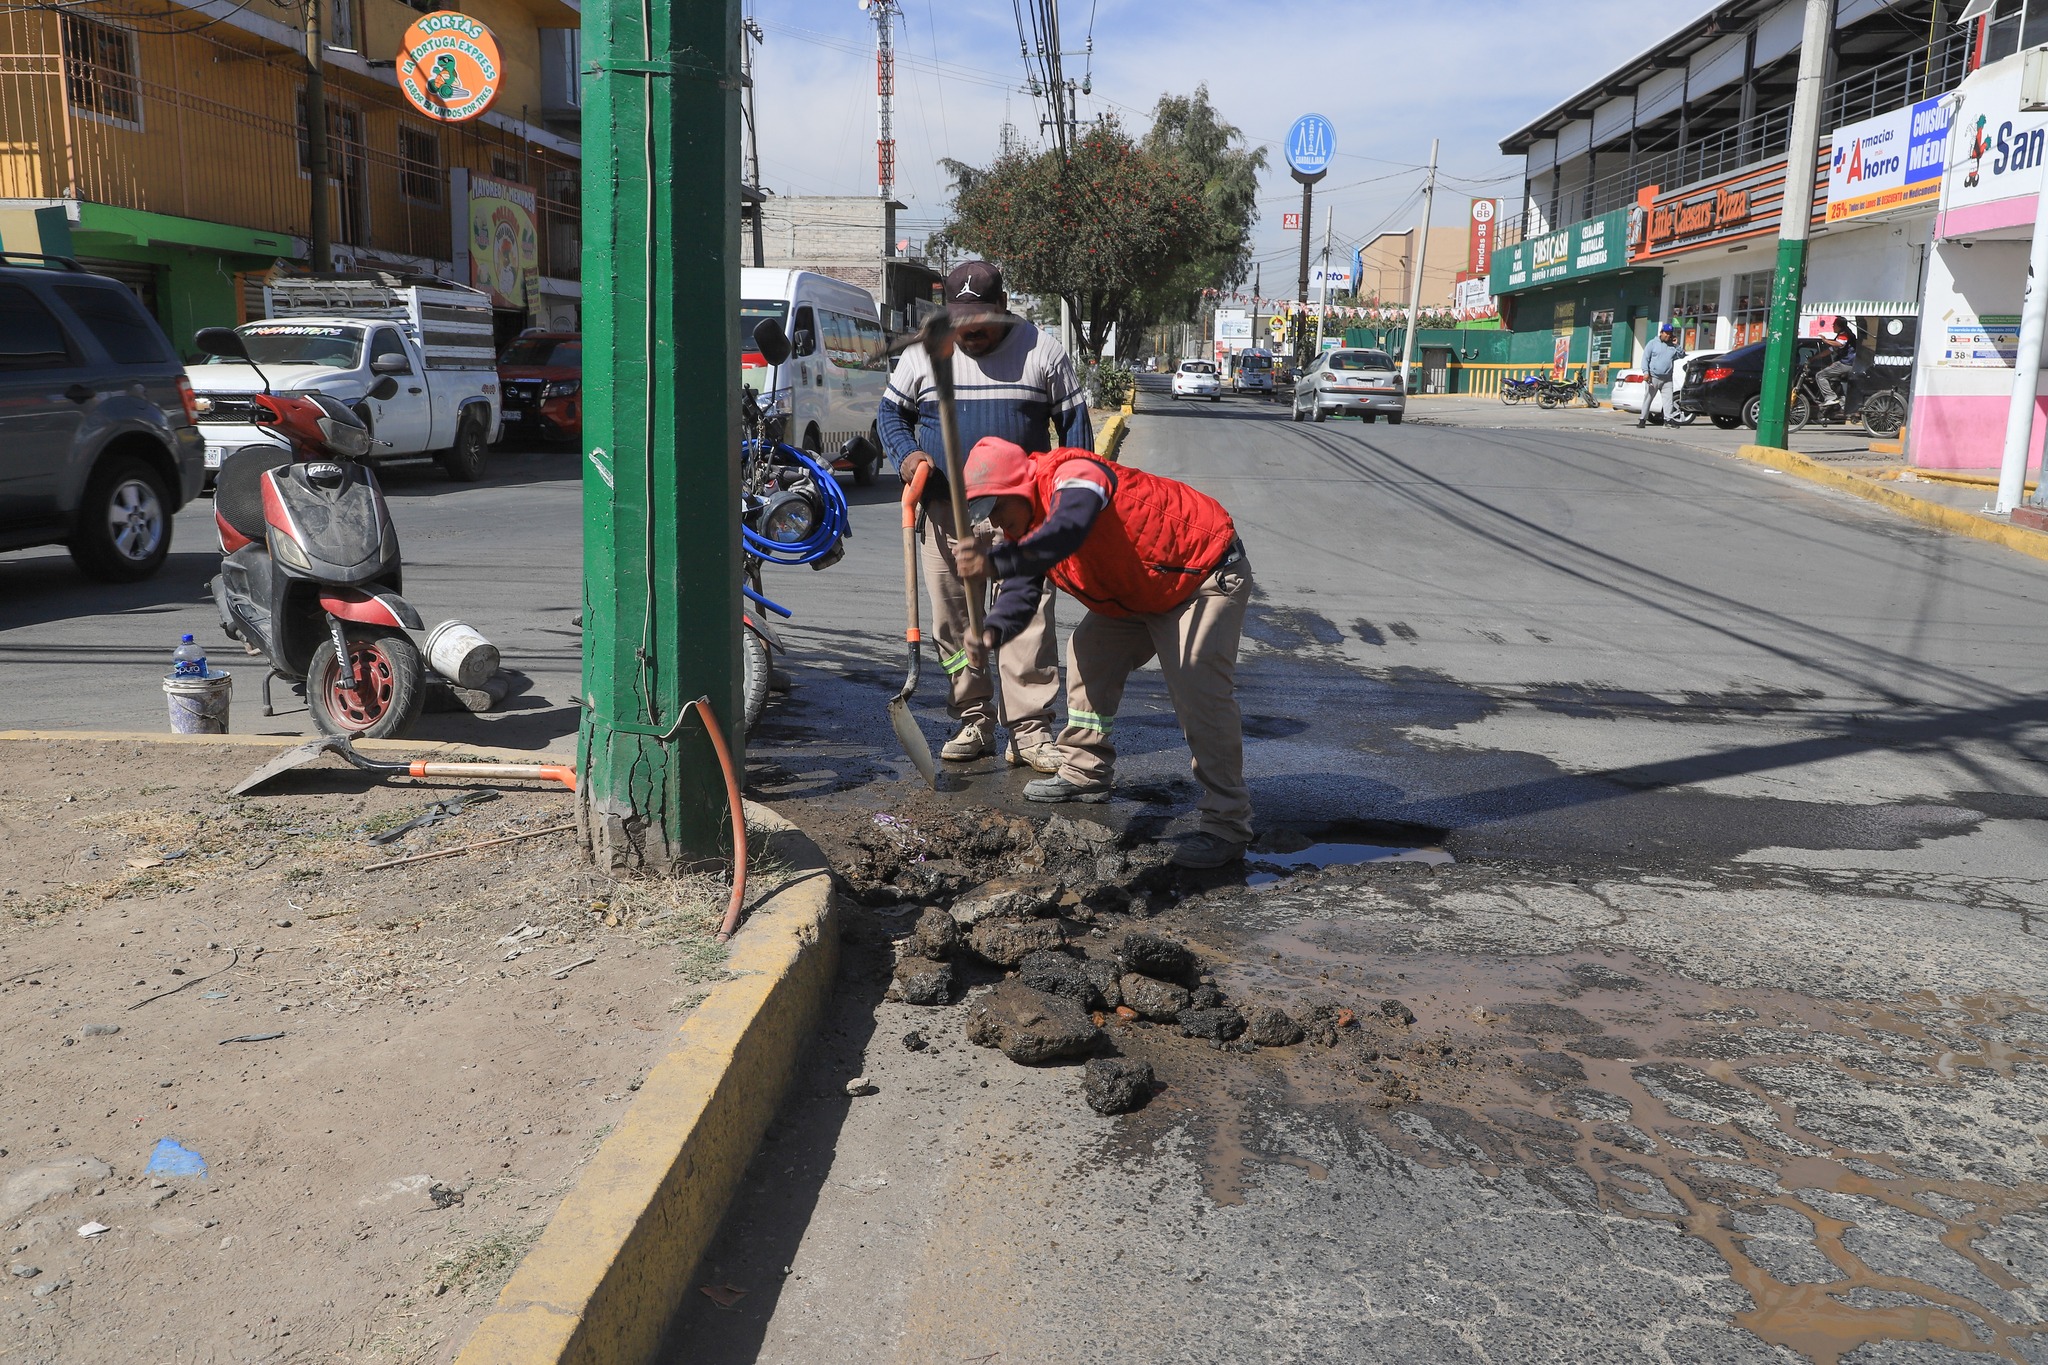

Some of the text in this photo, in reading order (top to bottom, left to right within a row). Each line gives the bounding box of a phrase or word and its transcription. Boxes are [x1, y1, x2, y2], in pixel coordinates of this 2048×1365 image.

[418, 14, 483, 39] TORTAS
[402, 37, 496, 80] LA TORTUGA EXPRESS
[404, 78, 493, 118] SABOR EN UN DOS POR TRES
[1847, 137, 1899, 184] Ahorro
[1993, 120, 2044, 175] San
[1285, 214, 1297, 224] 24
[1476, 210, 1490, 218] BB
[1480, 202, 1487, 210] B
[1714, 187, 1747, 225] Pizza
[1831, 202, 1847, 219] 25%
[1476, 223, 1487, 273] Tiendas 3B
[331, 629, 345, 666] ITALIKA
